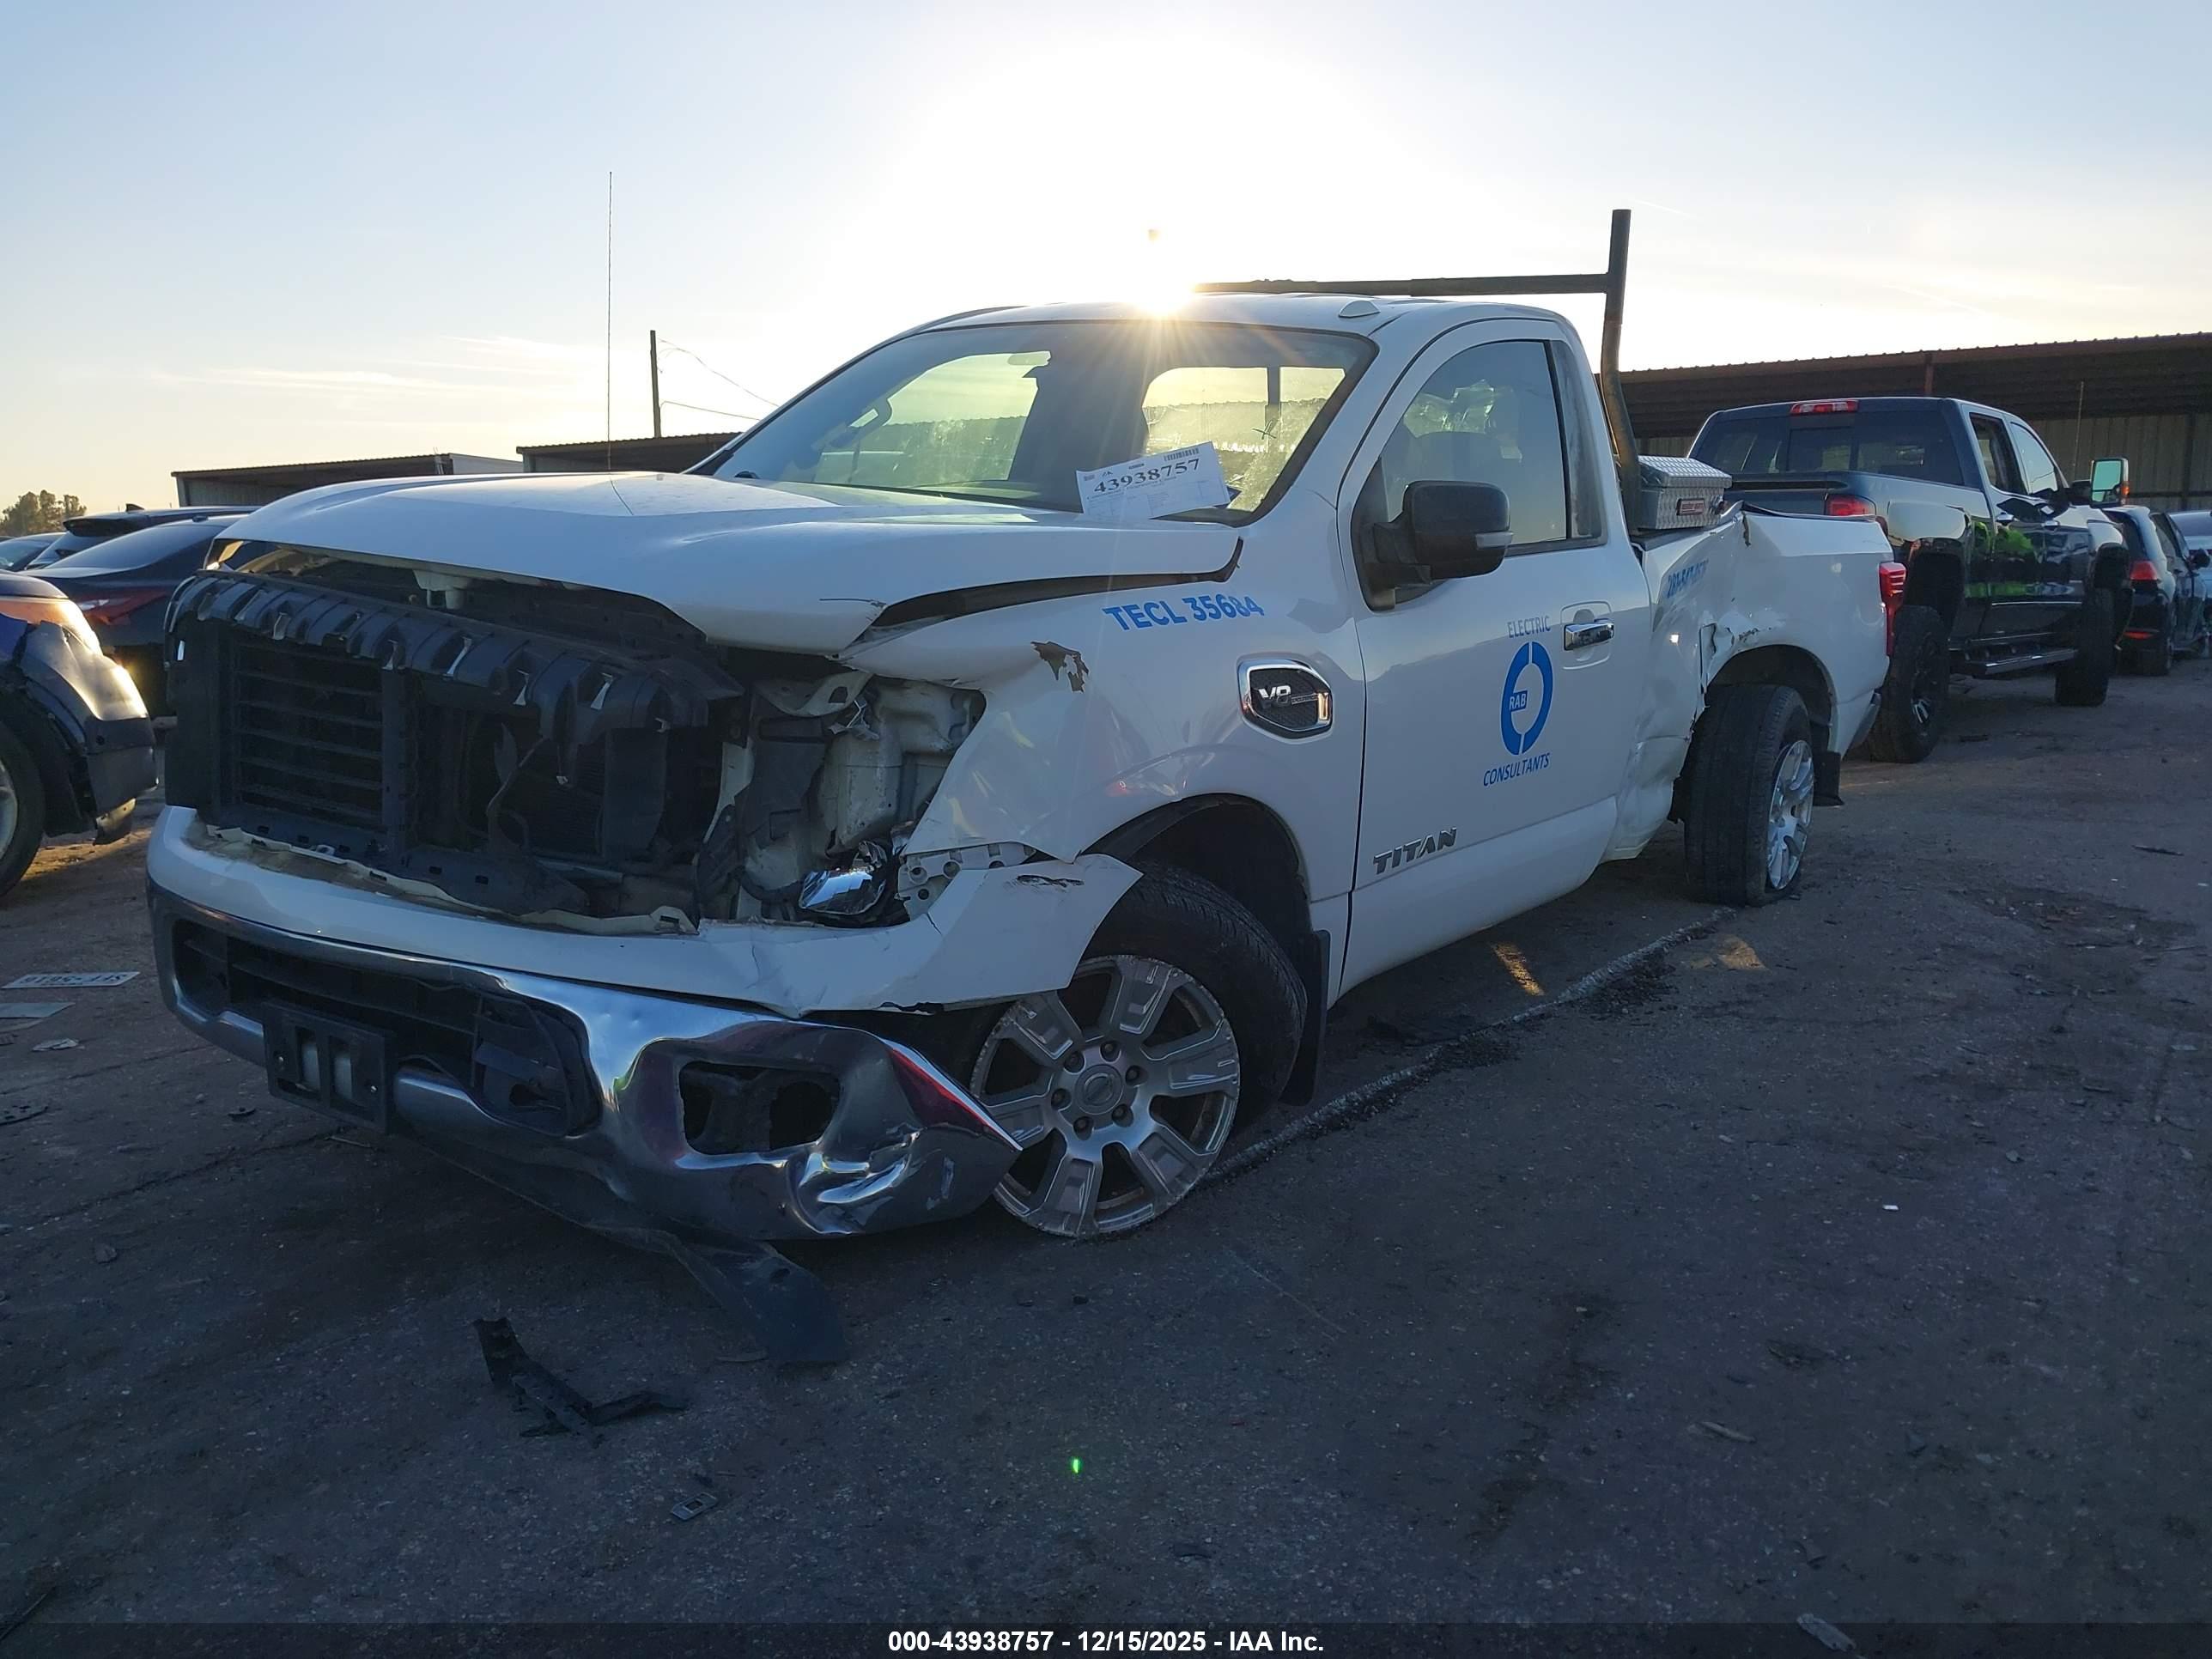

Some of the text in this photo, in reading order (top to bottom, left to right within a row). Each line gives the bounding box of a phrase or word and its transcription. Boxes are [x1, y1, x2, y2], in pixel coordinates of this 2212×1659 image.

[1094, 459, 1200, 493] 43938757
[1102, 594, 1264, 630] TECL 35684
[1507, 616, 1551, 638] ELECTRIC
[1258, 684, 1291, 704] V8
[1509, 693, 1527, 710] RAB
[1483, 753, 1550, 786] CONSULTANTS
[1373, 827, 1456, 874] TITAN
